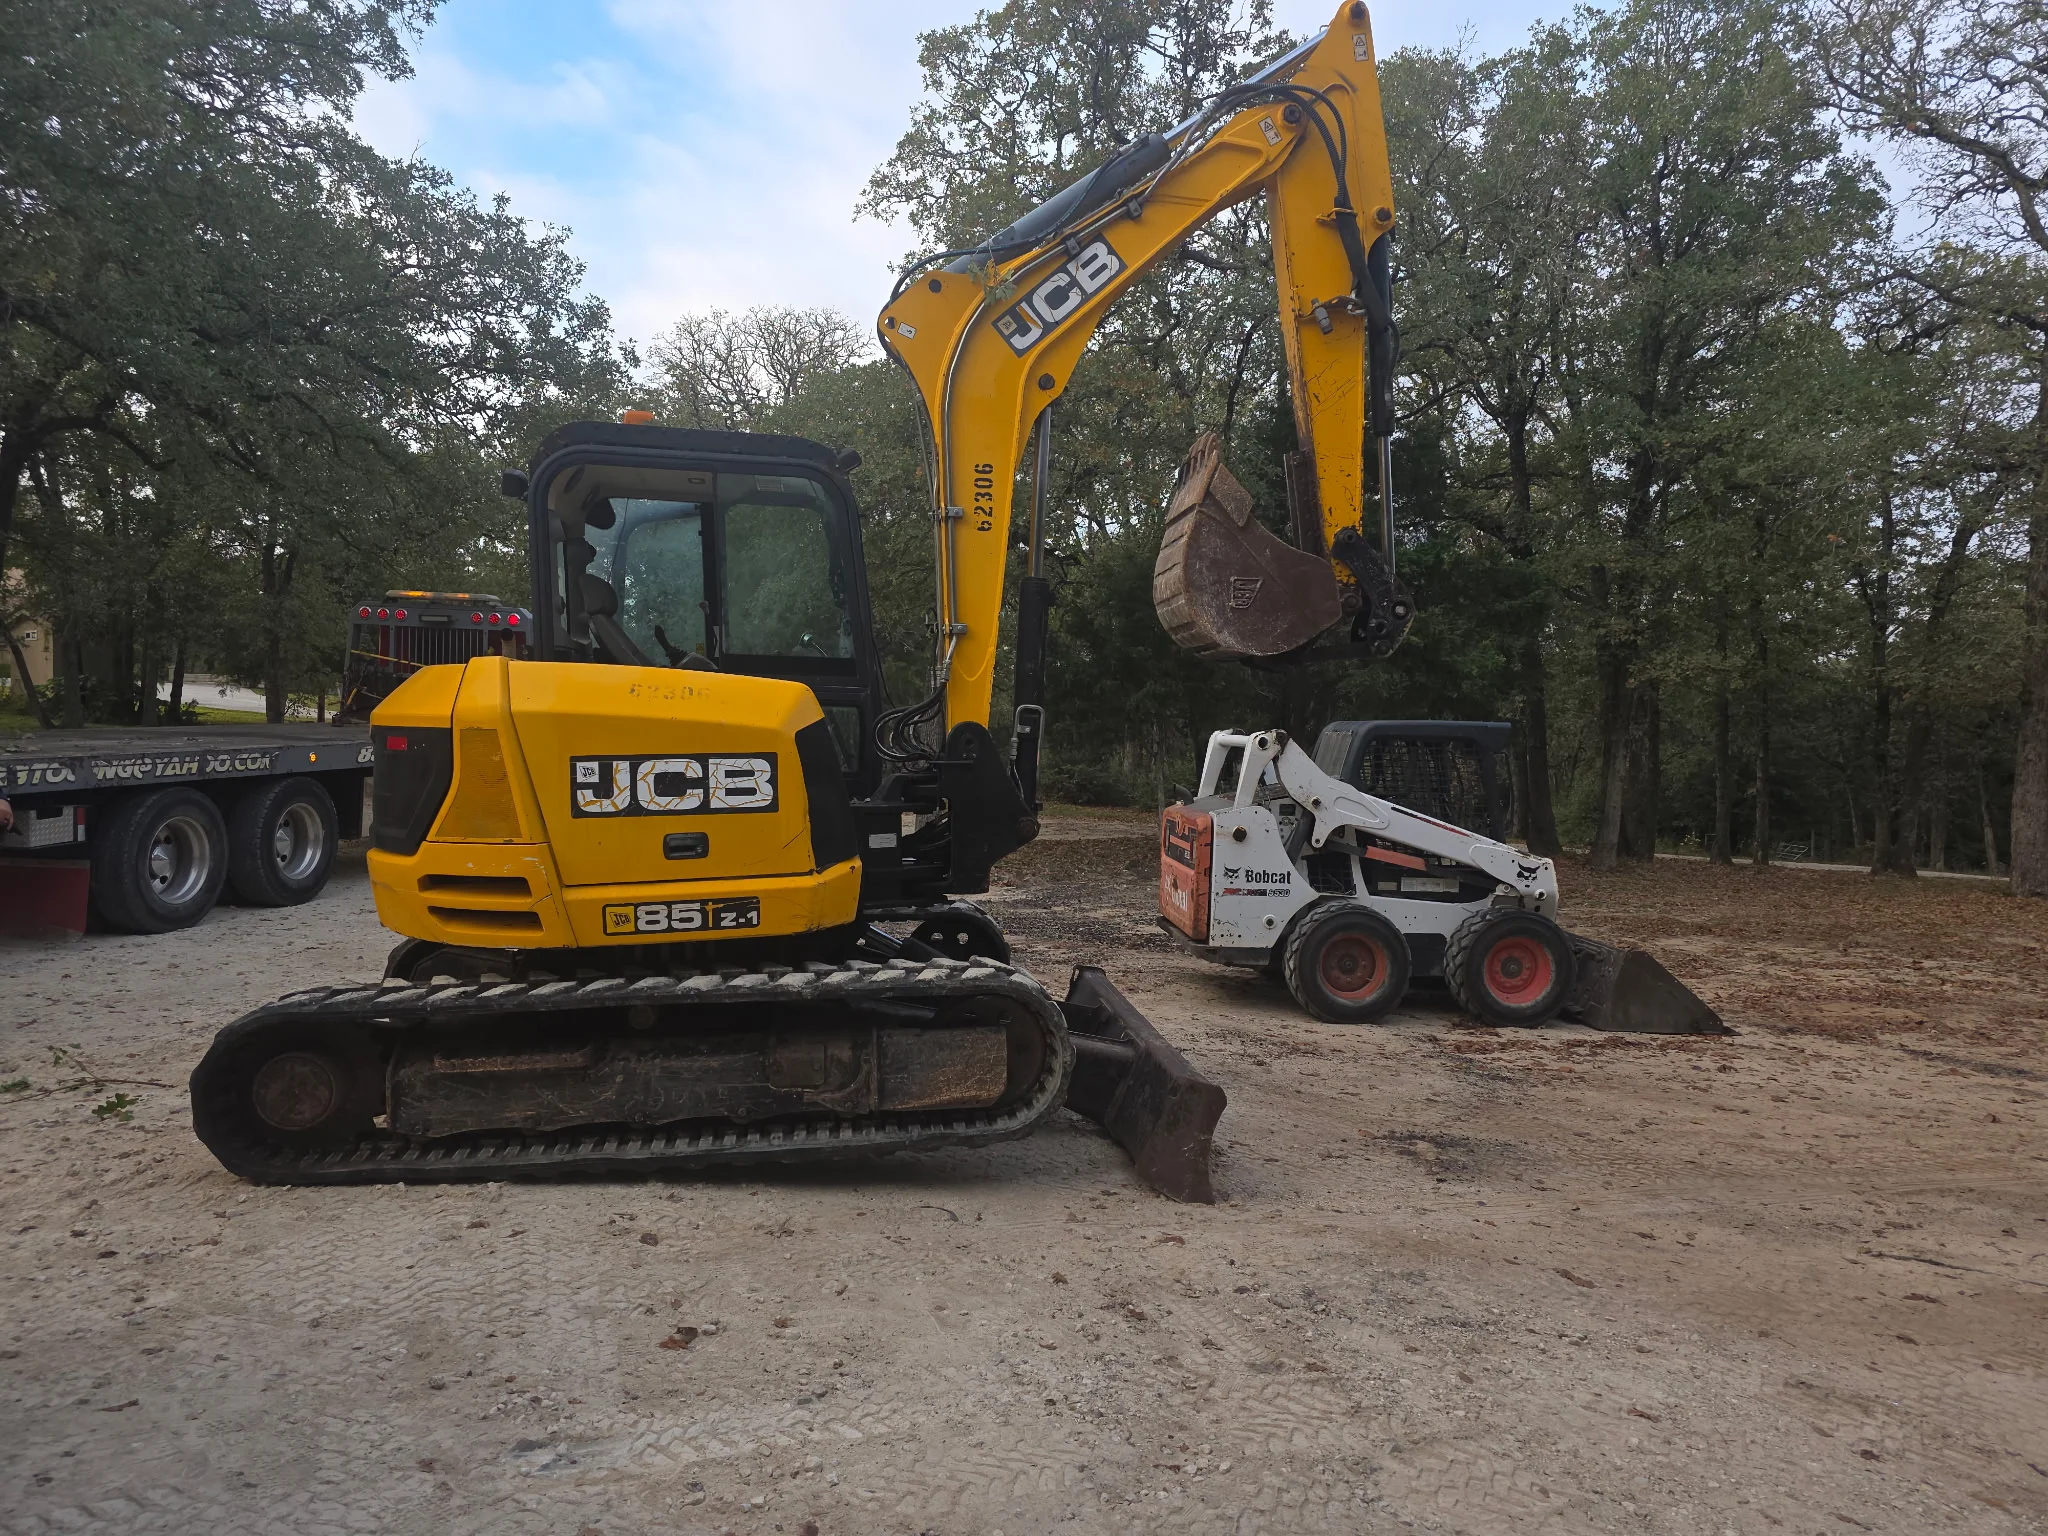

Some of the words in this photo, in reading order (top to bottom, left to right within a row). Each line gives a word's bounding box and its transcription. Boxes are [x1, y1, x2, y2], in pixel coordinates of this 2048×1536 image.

[1009, 241, 1120, 349] JCB
[973, 463, 994, 532] 62306
[576, 758, 774, 812] JCB
[1245, 869, 1291, 884] Bobcat
[613, 912, 630, 927] JCB
[636, 903, 703, 931] 85
[720, 910, 758, 927] Z-1
